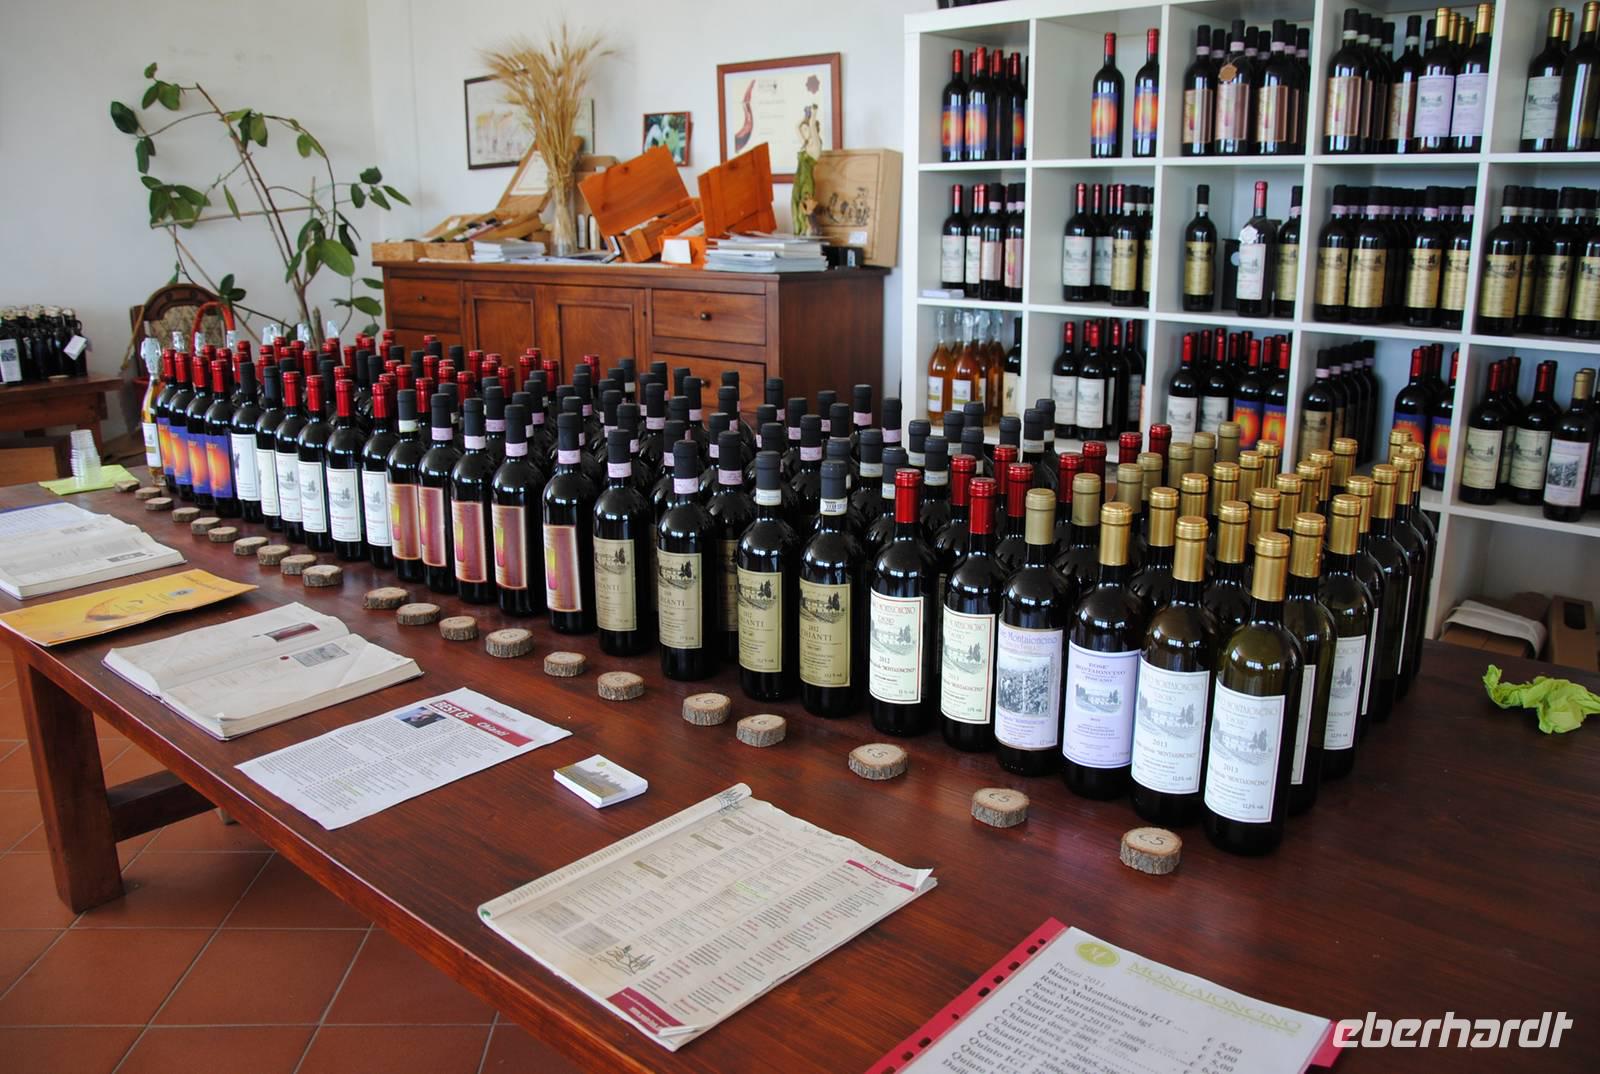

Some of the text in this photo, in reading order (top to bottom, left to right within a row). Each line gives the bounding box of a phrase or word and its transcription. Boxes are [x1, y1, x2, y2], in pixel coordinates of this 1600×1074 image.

[435, 701, 462, 714] BEST
[455, 711, 473, 720] OF
[477, 722, 510, 737] Chianti
[1055, 961, 1106, 989] Prezzi 2011
[1017, 995, 1054, 1016] Chianti
[1025, 988, 1062, 1009] Chianti
[1032, 981, 1125, 1026] Rosé Montaioncino
[1040, 974, 1068, 993] Rosso
[1072, 989, 1137, 1021] Montaioncino
[1047, 968, 1174, 1026] Bianco Montaioncino IGT
[1130, 961, 1302, 1031] MONTAIONCINO
[1002, 1008, 1038, 1030] Chianti
[1009, 1001, 1046, 1023] Chianti
[977, 1029, 1012, 1050] Quinto
[985, 1022, 1023, 1044] Chianti
[1024, 1043, 1059, 1061] riserva
[994, 1014, 1031, 1037] Chianti
[1032, 1036, 1067, 1054] riserva
[960, 1043, 995, 1066] Quinto
[969, 1036, 1004, 1058] Quinto
[951, 1051, 986, 1074] Quinto
